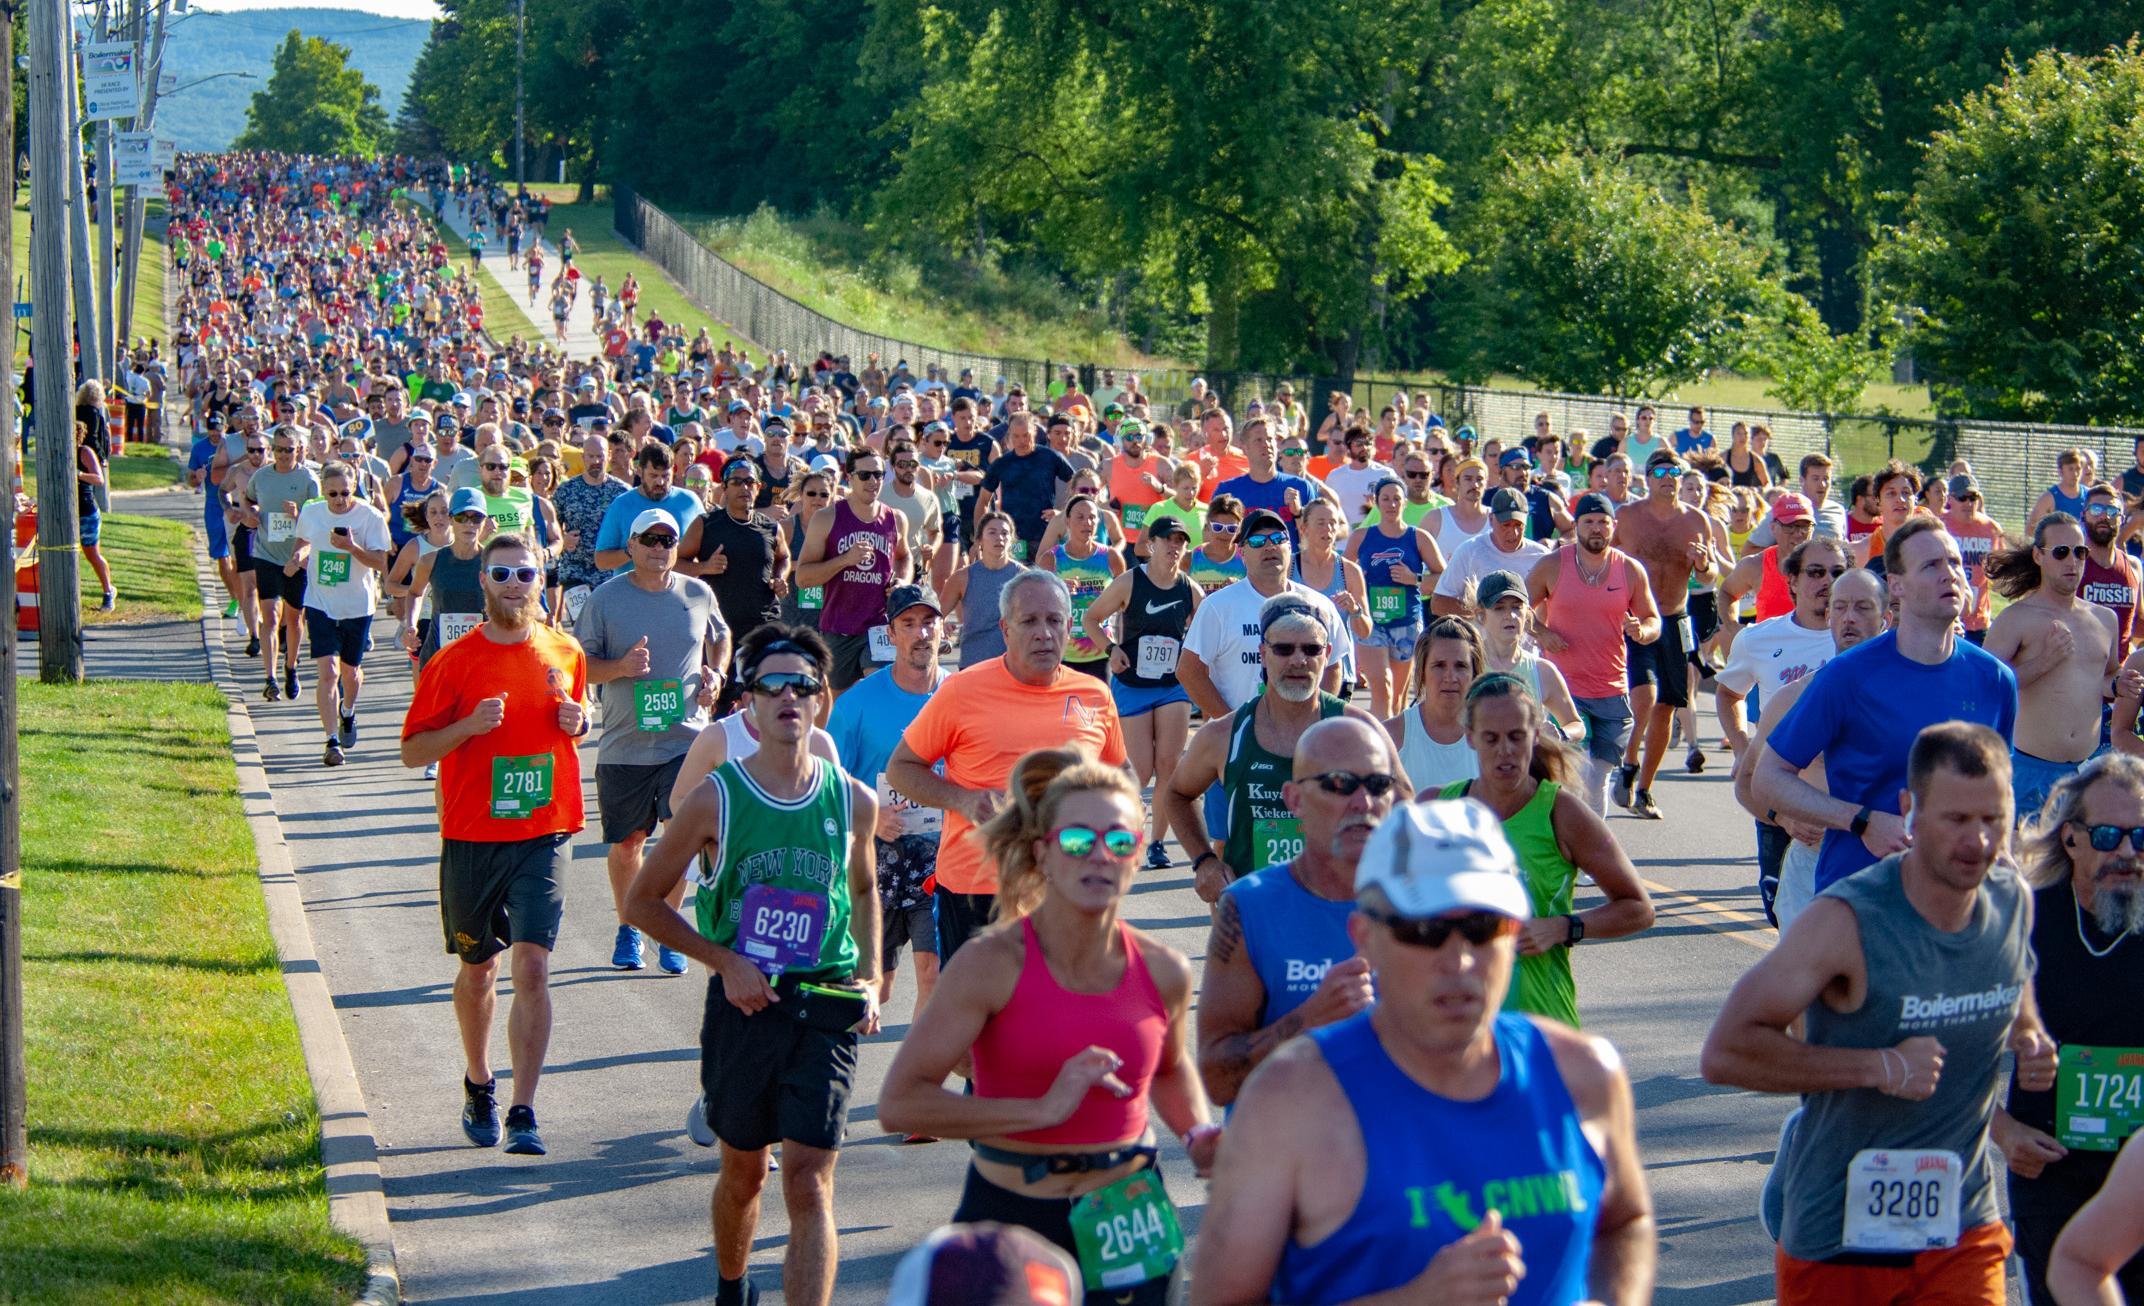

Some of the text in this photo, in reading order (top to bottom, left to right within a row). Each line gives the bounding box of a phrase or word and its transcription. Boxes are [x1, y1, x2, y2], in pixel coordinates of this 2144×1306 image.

[272, 519, 292, 531] 3344
[322, 559, 346, 575] 2348
[843, 570, 882, 585] DRAGONS
[1080, 580, 1104, 588] BODY
[1375, 595, 1400, 610] 1981
[1072, 608, 1088, 622] 27
[1145, 645, 1173, 662] 3797
[643, 691, 678, 712] 2593
[503, 770, 543, 794] 2781
[737, 846, 841, 893] NEW YORK
[754, 906, 812, 944] 6230
[1898, 1020, 1938, 1031] MORE
[1943, 1013, 1977, 1027] THAN
[2075, 1072, 2141, 1109] 1724
[1868, 1180, 1940, 1218] 3286
[1095, 1200, 1166, 1262] 2644
